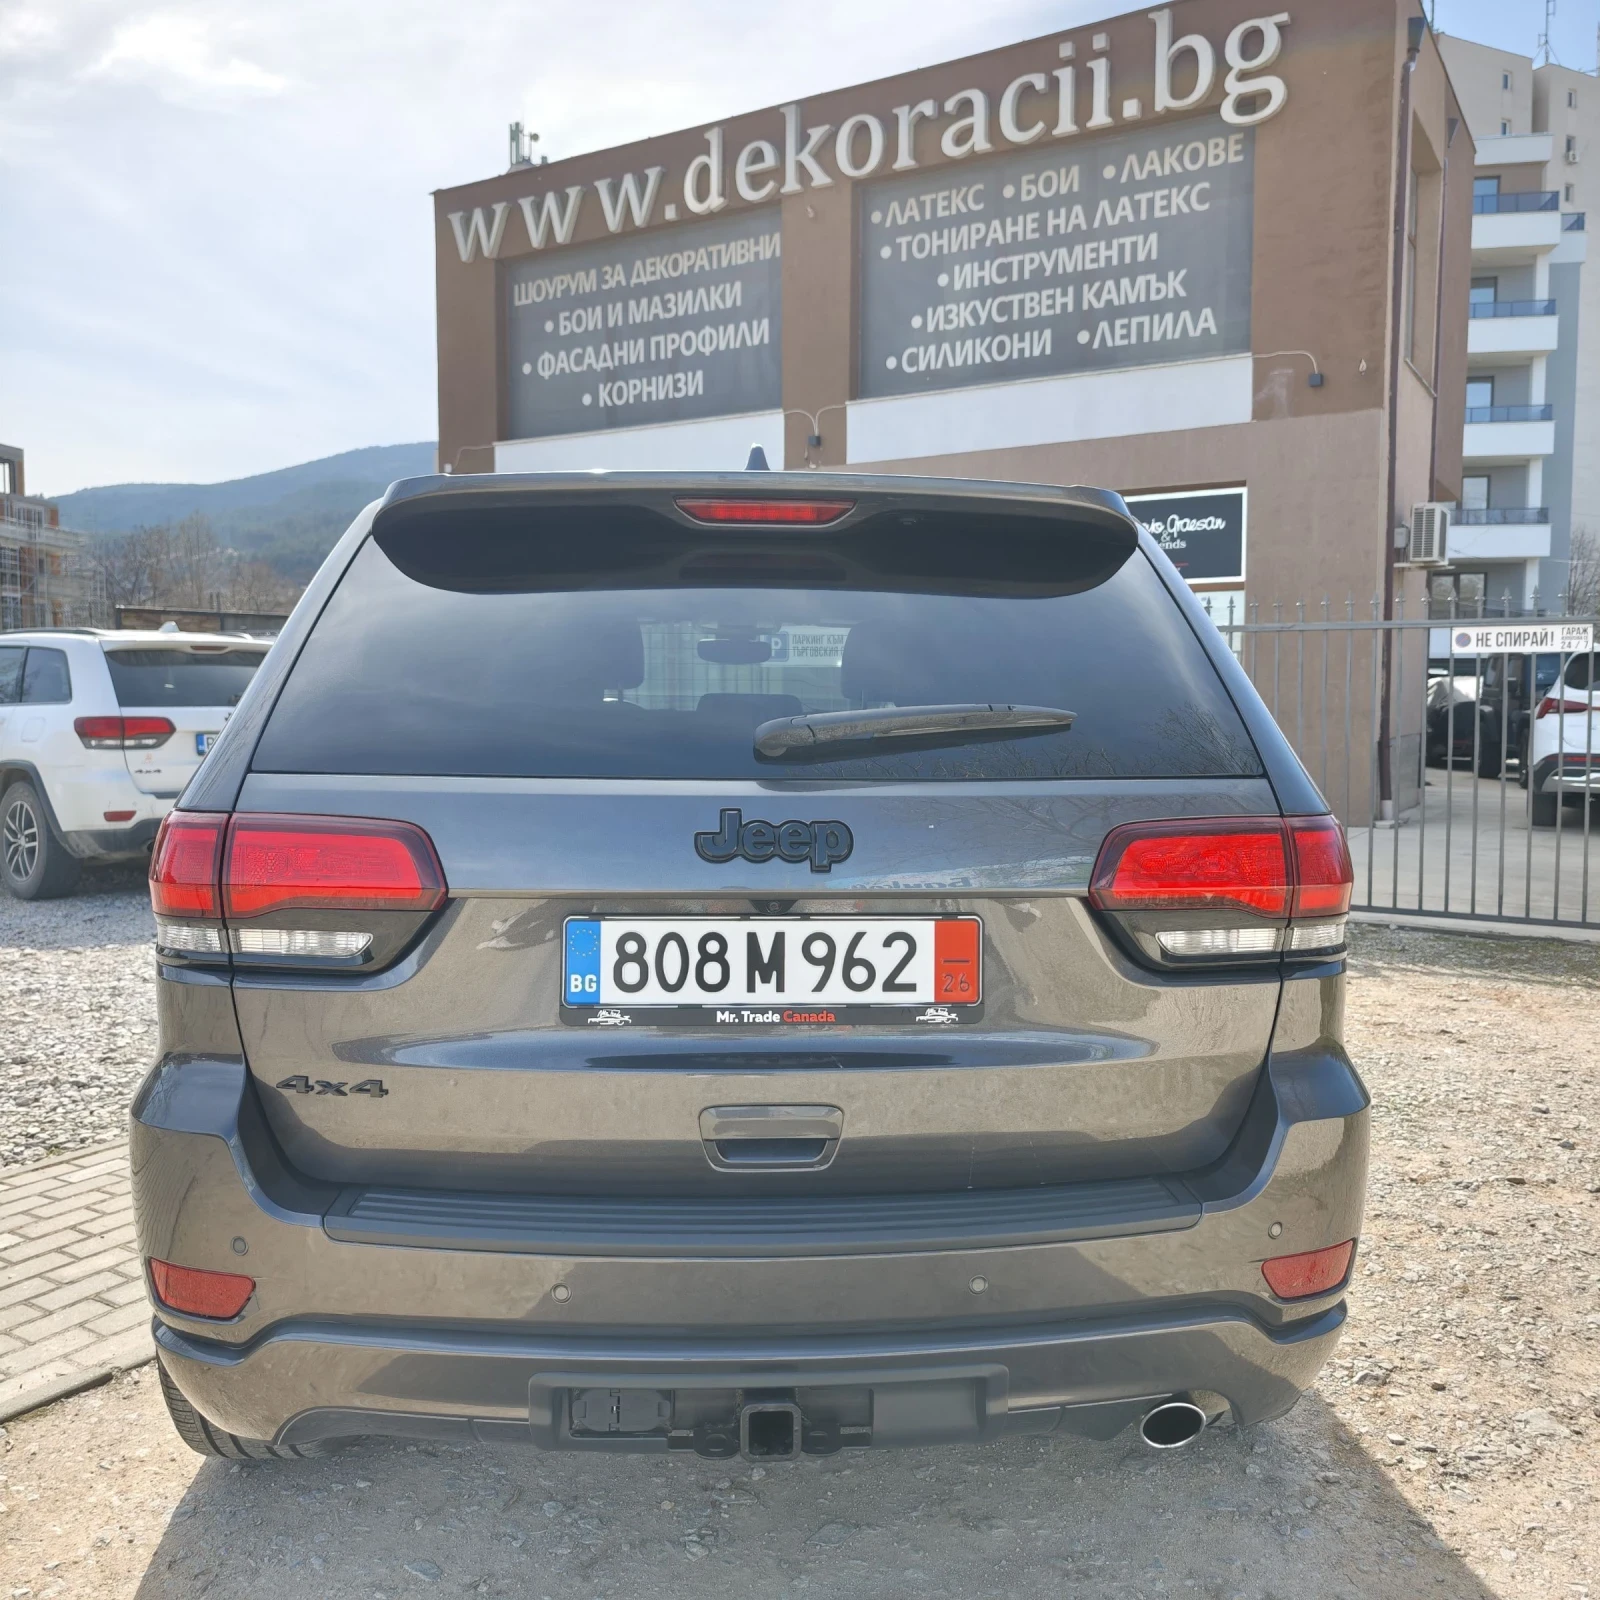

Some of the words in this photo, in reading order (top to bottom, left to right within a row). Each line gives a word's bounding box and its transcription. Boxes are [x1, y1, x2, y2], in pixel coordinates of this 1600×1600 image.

[447, 9, 1291, 264] www.dekoracii.bg
[885, 184, 984, 227] ЛАТЕКС
[1021, 165, 1079, 202] БОИ
[1120, 133, 1244, 183] ЛАКОВЕ
[896, 212, 1040, 262] ТОНИРАНЕ
[1047, 205, 1086, 236] НА
[1093, 182, 1210, 229] ЛАТЕКС
[513, 269, 597, 306] ШОУРУМ
[601, 263, 626, 290] ЗА
[630, 232, 781, 287] ДЕКОРАТИВНИ
[953, 232, 1158, 291] ИНСТРУМЕНТИ
[559, 305, 602, 336] БОИ
[608, 304, 623, 327] И
[629, 281, 742, 325] МАЗИЛКИ
[926, 285, 1074, 333] ИЗКУСТВЕН
[1082, 269, 1187, 310] КАМЪК
[537, 338, 644, 380] ФАСАДНИ
[650, 318, 769, 361] ПРОФИЛИ
[901, 328, 1052, 373] СИЛИКОНИ
[1092, 307, 1217, 349] ЛЕПИЛА
[599, 370, 703, 408] КОРНИЗИ
[1157, 539, 1187, 550] ends
[792, 635, 823, 645] ПАРКИНГ
[827, 635, 844, 645] КЪМ
[792, 646, 839, 657] ТЪРГОВСКИЯ
[1476, 632, 1492, 647] НЕ
[1496, 628, 1554, 647] СПИРАЙ!
[1561, 627, 1589, 636] ГАРАЖ
[695, 808, 853, 872] Jeep
[570, 974, 597, 993] BG
[613, 932, 730, 993] 808
[747, 932, 785, 993] M
[802, 932, 917, 993] 962
[943, 973, 970, 993] 26
[716, 1010, 739, 1023] Mr.
[741, 1010, 780, 1023] Trade
[783, 1010, 836, 1023] Canada
[276, 1075, 389, 1098] 4x4
